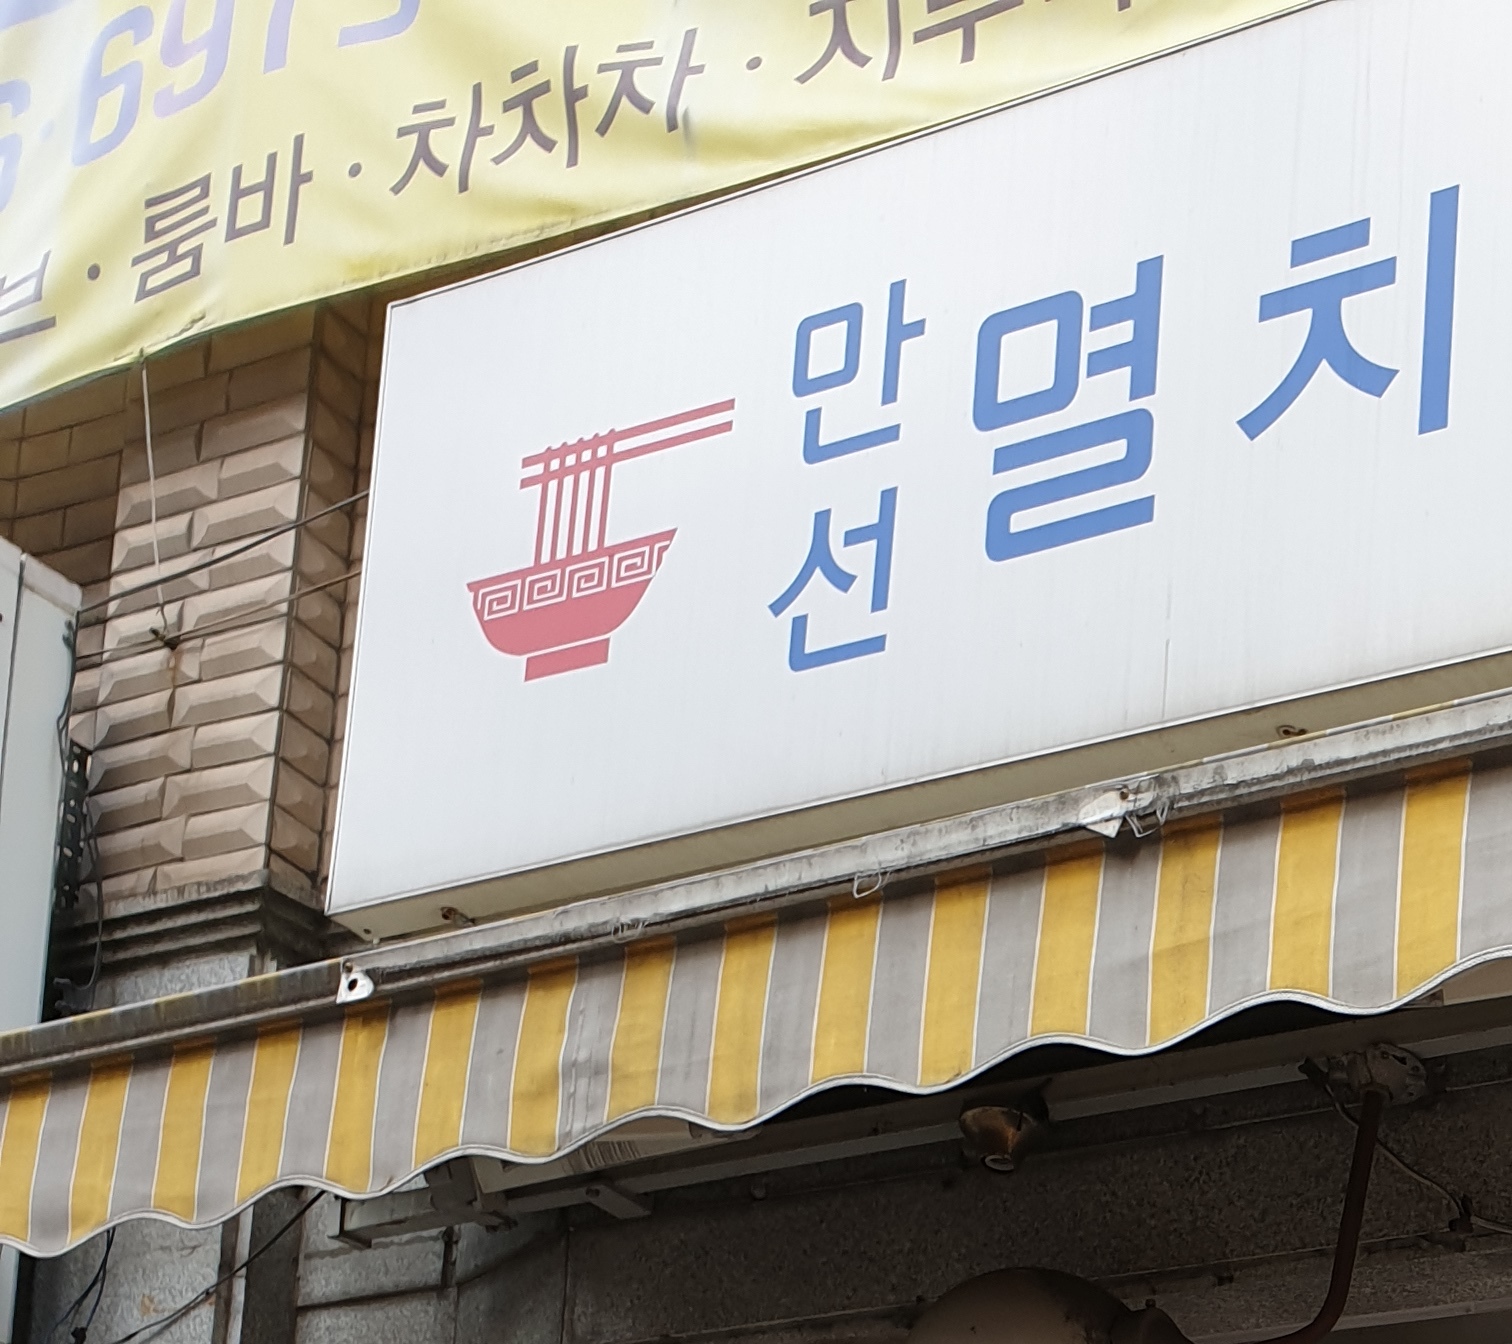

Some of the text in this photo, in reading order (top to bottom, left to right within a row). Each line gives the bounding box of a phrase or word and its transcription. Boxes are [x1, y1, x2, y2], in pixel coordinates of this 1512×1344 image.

[131, 133, 312, 302] 룸바
[390, 28, 704, 195] 차차차
[971, 185, 1461, 563] 멸치
